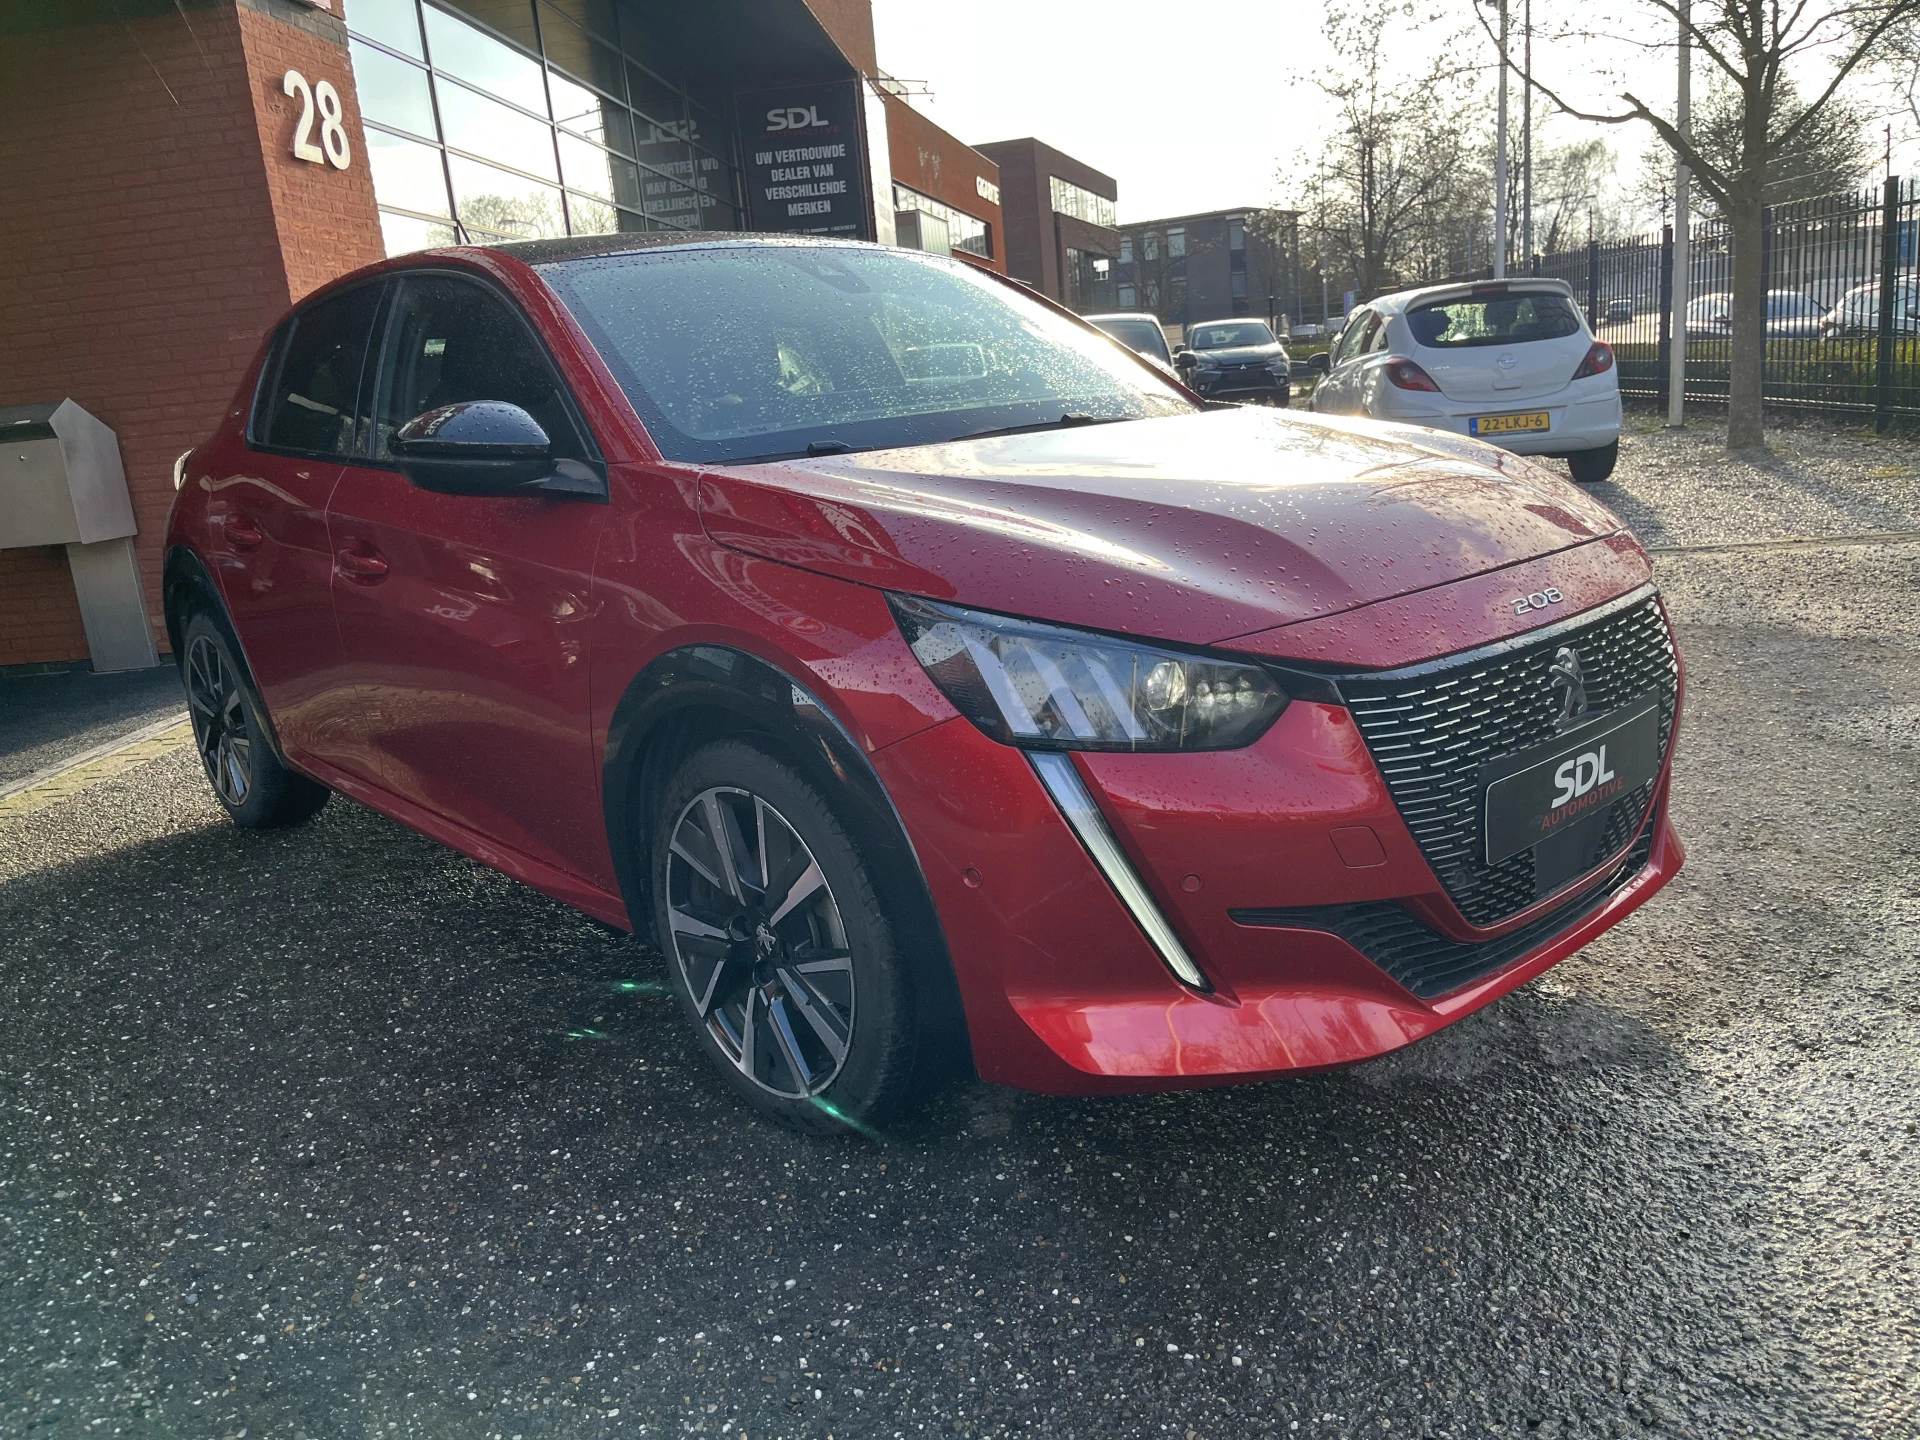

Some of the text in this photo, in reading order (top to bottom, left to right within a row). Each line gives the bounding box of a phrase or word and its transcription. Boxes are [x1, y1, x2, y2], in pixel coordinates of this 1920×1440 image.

[284, 69, 350, 170] 28
[766, 106, 829, 131] SDL
[755, 144, 846, 165] UW VERTROUWDE
[771, 163, 834, 182] DEALER VAN
[765, 181, 847, 200] VERSCHILLENDE
[787, 200, 831, 216] MERKEN
[1483, 415, 1543, 431] 22-LKJ-6
[1509, 587, 1564, 616] 208
[1551, 744, 1615, 809] SDL
[1541, 776, 1624, 830] AUTOMOTIVE
